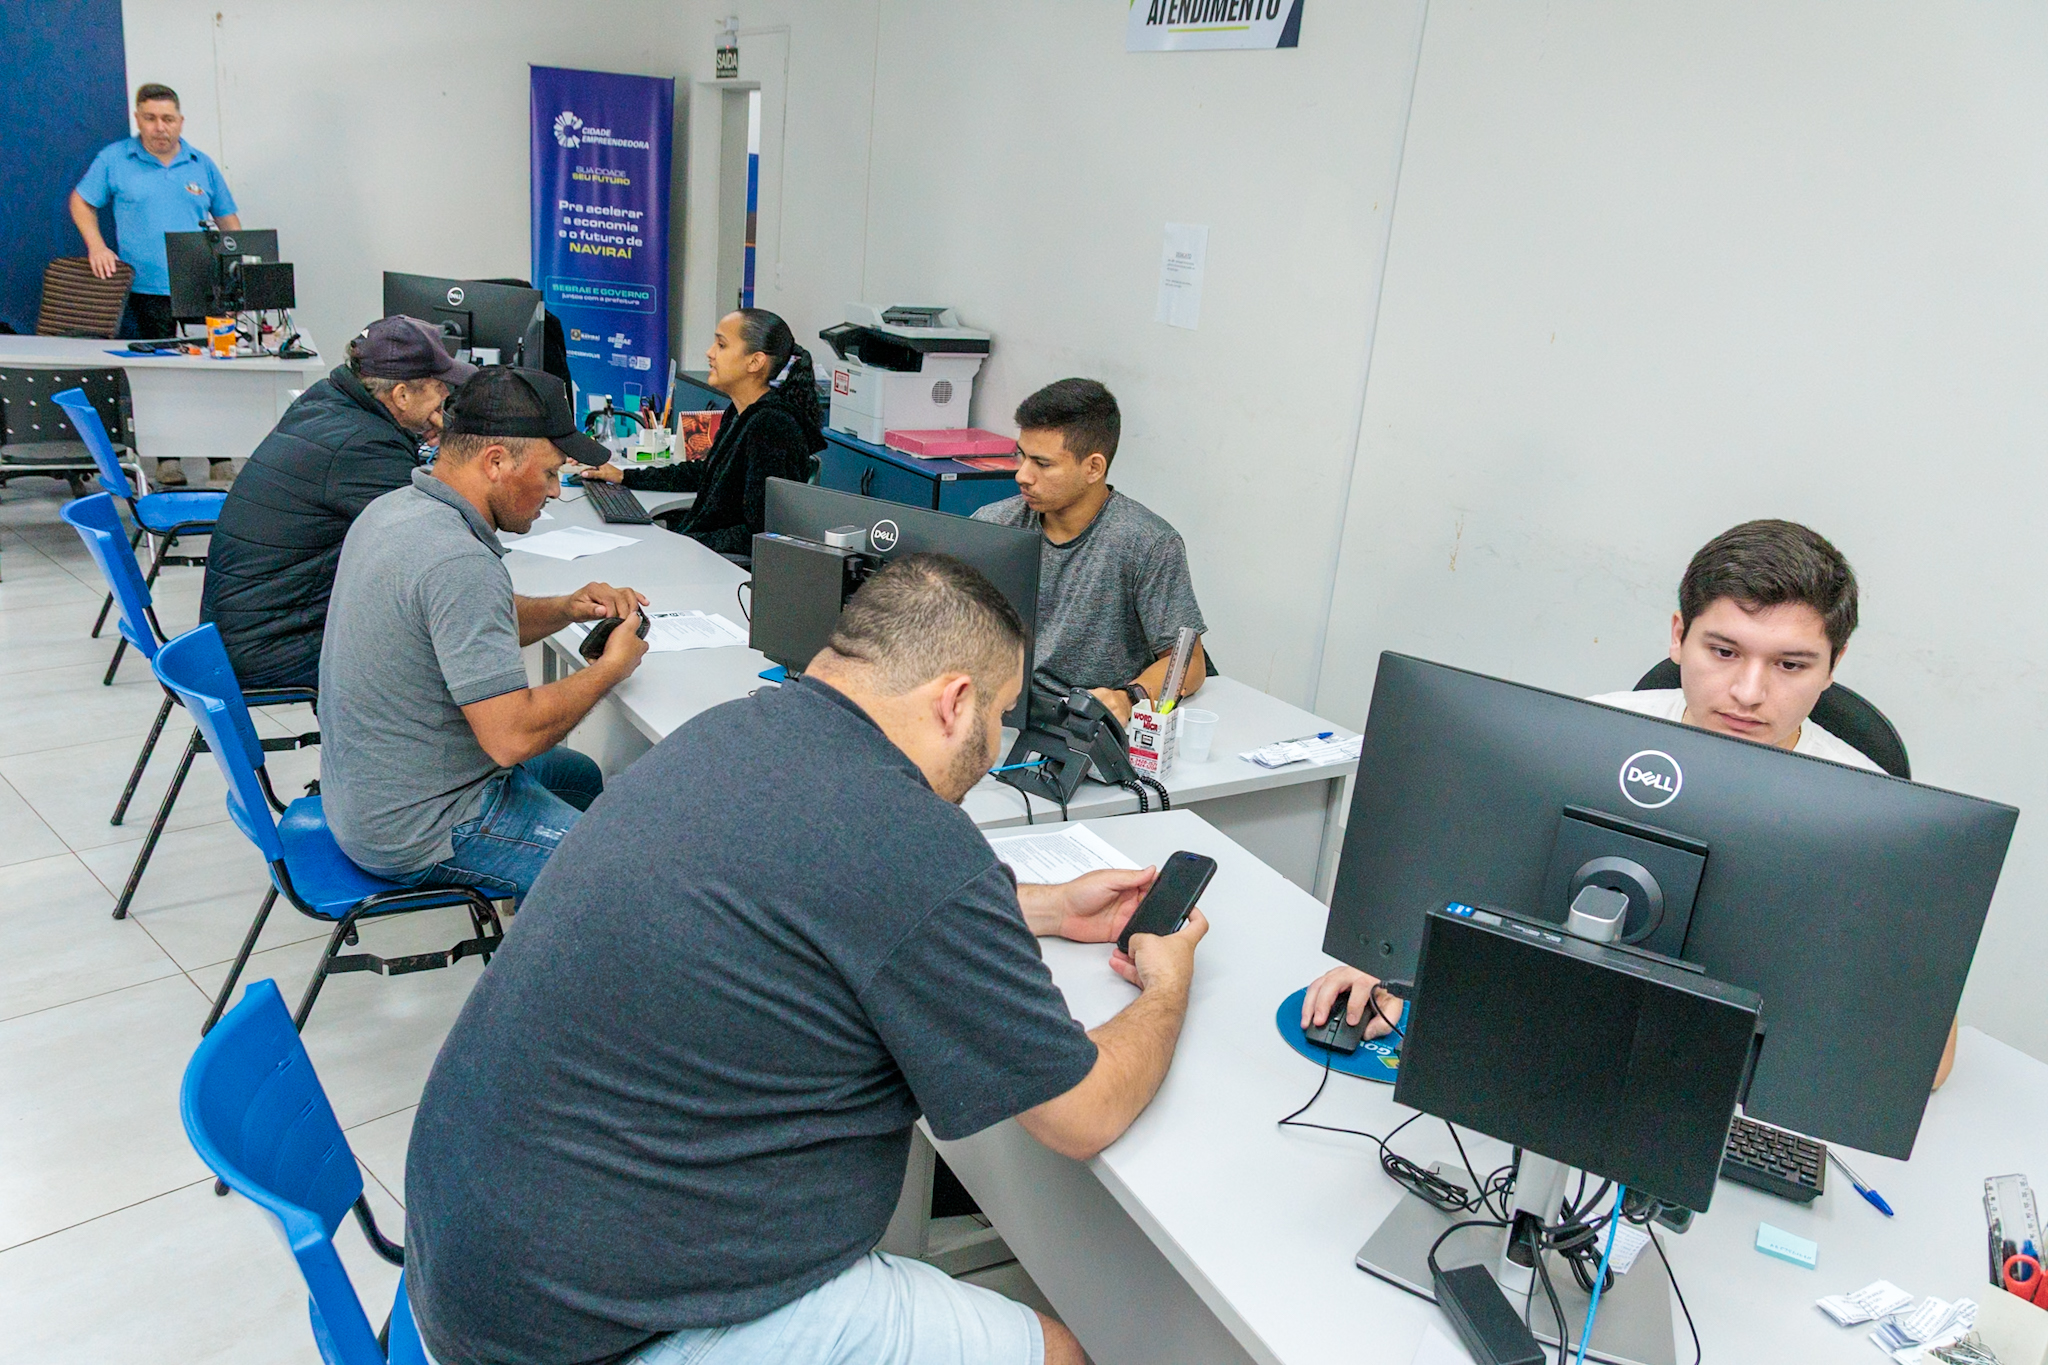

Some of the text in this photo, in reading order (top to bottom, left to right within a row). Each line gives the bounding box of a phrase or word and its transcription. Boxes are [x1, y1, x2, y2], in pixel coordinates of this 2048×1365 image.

[1146, 0, 1281, 26] ATENDIMENTO
[581, 126, 611, 137] CIDADE
[581, 135, 650, 150] EMPREENDEDORA
[576, 165, 594, 174] SUA
[572, 172, 631, 186] SEU FUTURO
[558, 199, 644, 219] Pra acelerar
[563, 216, 639, 233] a economia
[558, 229, 643, 247] e o futuro de
[569, 242, 632, 259] NAVIRAÍ
[552, 283, 650, 300] SEBRAE E GOVERNO
[874, 529, 895, 542] DELL
[1133, 711, 1153, 723] WORD
[1627, 766, 1674, 793] DELL
